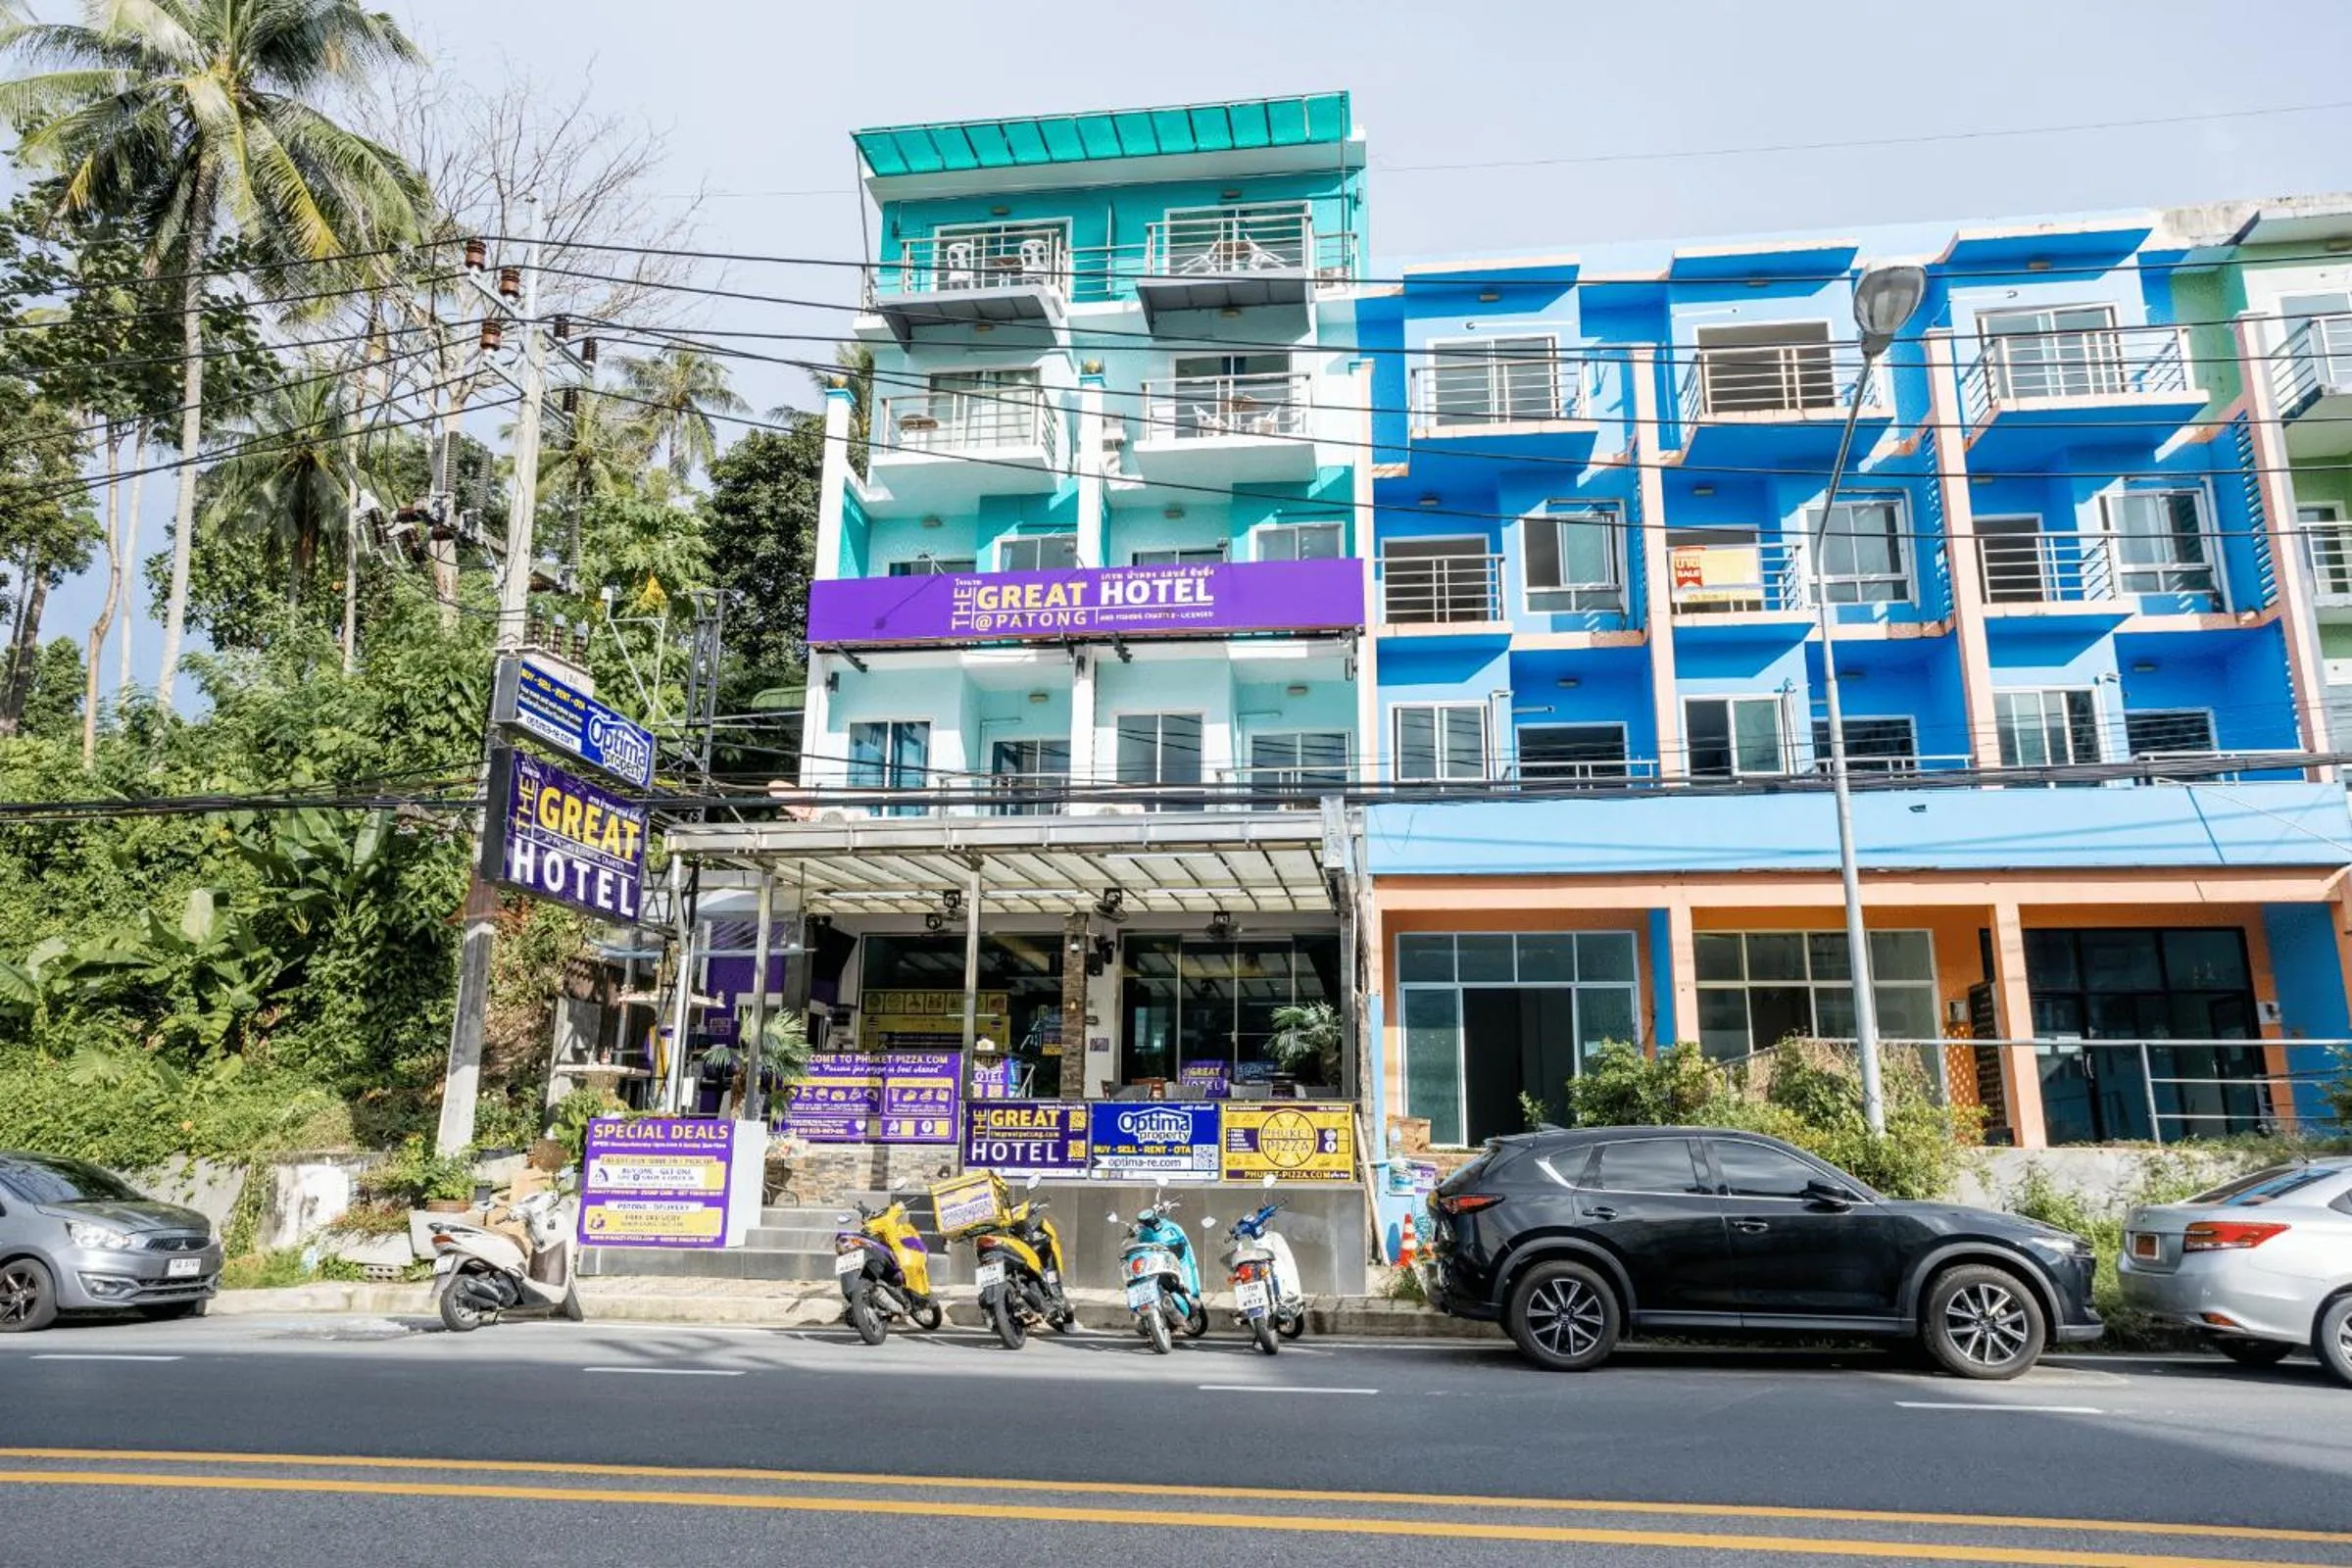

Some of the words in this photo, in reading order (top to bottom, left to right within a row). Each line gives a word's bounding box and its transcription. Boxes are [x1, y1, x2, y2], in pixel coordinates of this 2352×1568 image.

[977, 581, 1088, 610] GREAT
[1100, 578, 1215, 605] HOTEL
[952, 588, 973, 630] THE
[975, 611, 1088, 631] @PATONG
[590, 715, 647, 767] Optima
[605, 751, 646, 782] property
[515, 775, 535, 830] THE
[538, 786, 641, 860] GREAT
[512, 838, 635, 917] HOTEL
[839, 1054, 852, 1063] TO
[973, 1109, 987, 1139] THE
[990, 1109, 1060, 1127] GREAT
[1120, 1113, 1191, 1134] Optima
[593, 1123, 666, 1140] SPECIAL
[670, 1124, 729, 1140] DEALS
[1139, 1131, 1190, 1141] property
[1262, 1128, 1311, 1137] PHUKET
[971, 1143, 1059, 1161] HOTEL
[1093, 1145, 1110, 1154] BUY
[1116, 1145, 1137, 1154] SELL
[1144, 1145, 1167, 1154] RENT
[1173, 1145, 1192, 1154] OTA
[1266, 1141, 1309, 1152] PIZZA
[1107, 1156, 1182, 1167] optima-re.com
